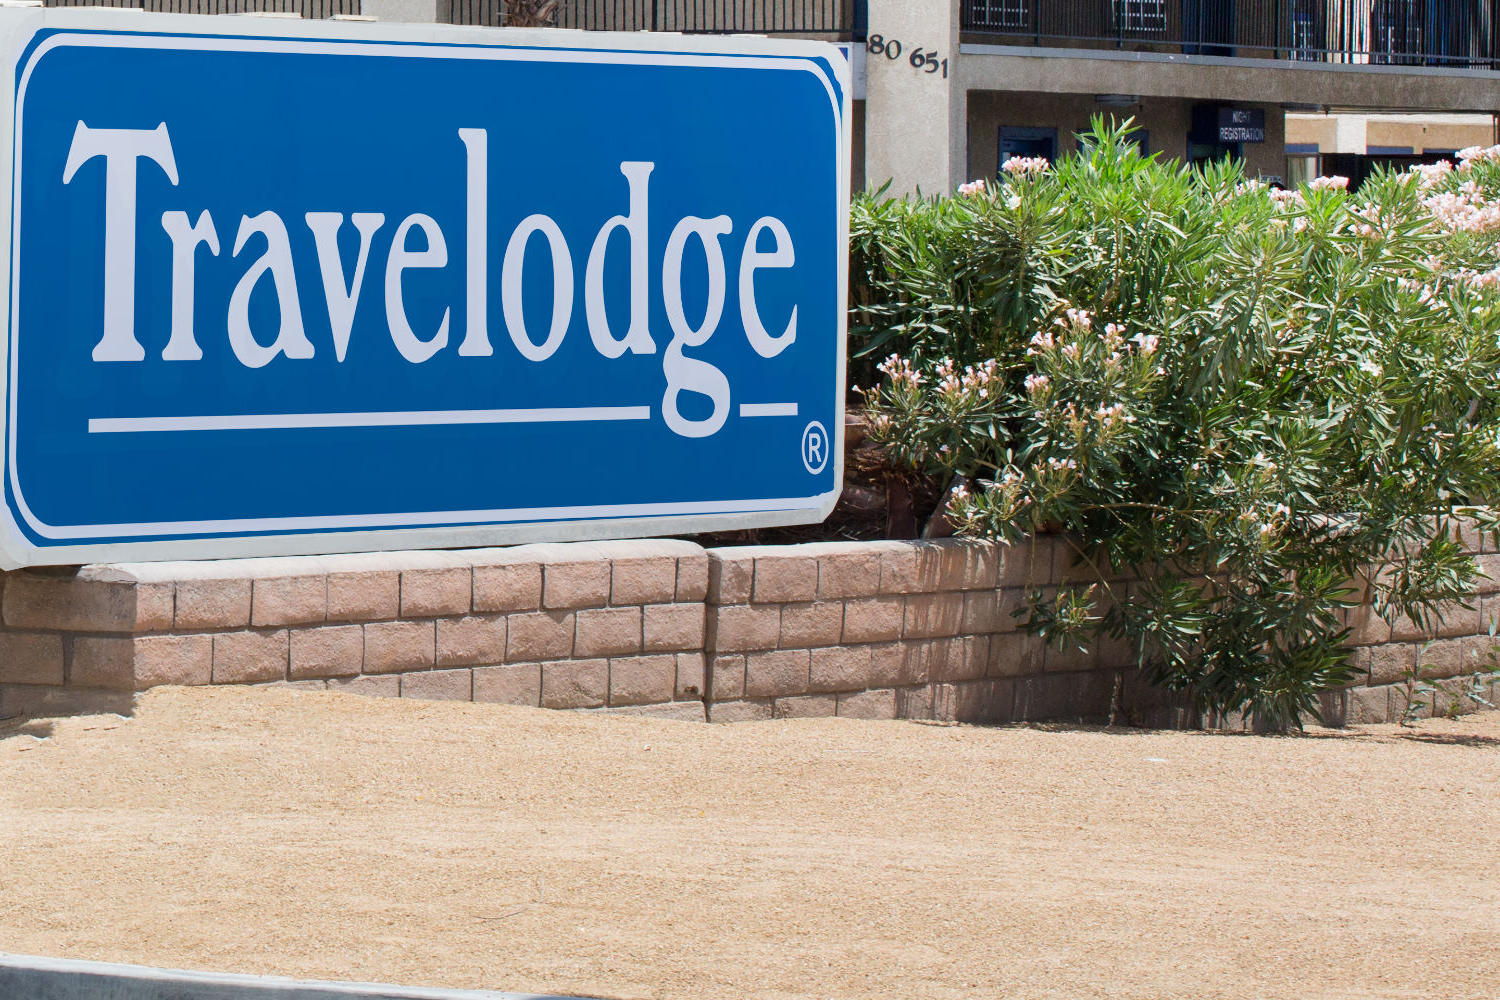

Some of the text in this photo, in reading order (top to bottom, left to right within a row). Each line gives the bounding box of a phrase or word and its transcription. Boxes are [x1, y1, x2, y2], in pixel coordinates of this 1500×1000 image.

[1232, 111, 1252, 123] NIGHT
[1219, 127, 1264, 141] REGISTRATION
[62, 119, 798, 438] Travelodge
